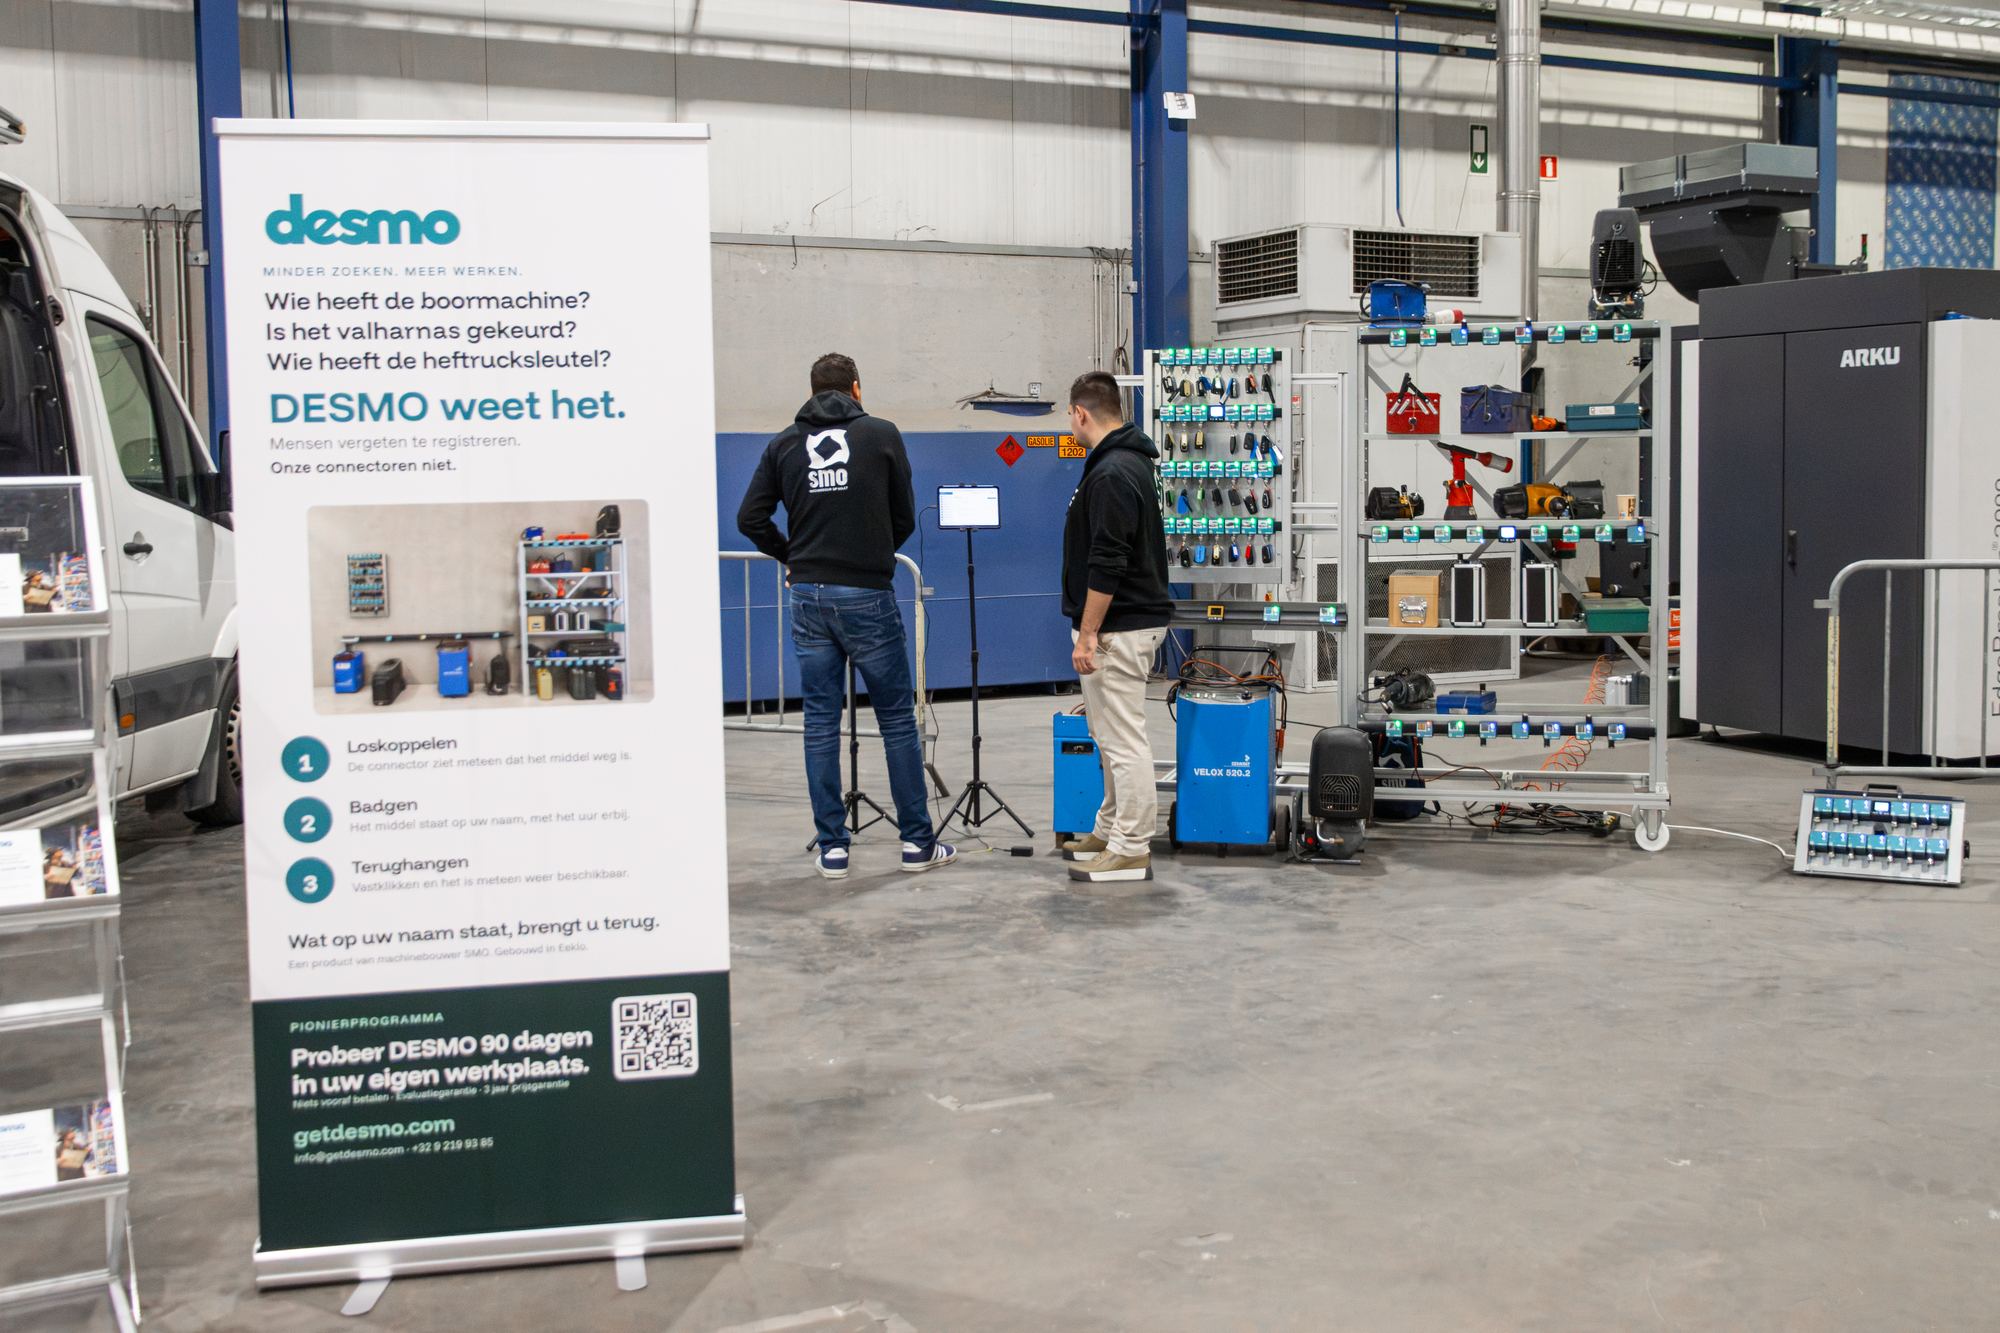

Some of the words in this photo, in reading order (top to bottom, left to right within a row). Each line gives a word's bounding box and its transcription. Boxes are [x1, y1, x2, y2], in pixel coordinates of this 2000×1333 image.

[265, 193, 460, 245] desmo
[263, 266, 325, 276] MINDER
[332, 266, 400, 276] ZOEKEN.
[404, 266, 445, 276] MEER
[453, 266, 521, 276] WERKEN.
[264, 292, 310, 310] Wie
[317, 291, 378, 310] heeft
[384, 291, 414, 309] de
[420, 291, 590, 309] boormachine?
[266, 322, 285, 340] Is
[292, 322, 330, 340] het
[337, 321, 460, 339] valharnas
[466, 320, 576, 343] gekeurd?
[267, 352, 312, 370] Wie
[319, 351, 380, 370] heeft
[387, 351, 416, 369] de
[423, 349, 610, 369] heftrucksleutel?
[1840, 346, 1900, 368] ARKU
[270, 391, 428, 423] DESMO
[440, 391, 540, 420] weet
[551, 389, 625, 419] het.
[270, 437, 332, 450] Mensen
[338, 436, 407, 452] vergeten
[412, 436, 427, 448] te
[432, 435, 520, 450] registreren.
[1028, 437, 1054, 446] GASOLIE
[1062, 447, 1084, 457] 1202
[270, 461, 311, 474] Onze
[316, 460, 416, 473] connectoren
[422, 459, 456, 471] niet.
[348, 737, 457, 754] Loskoppelen
[299, 754, 314, 773] 1
[347, 761, 365, 772] De
[367, 759, 428, 771] connector
[432, 758, 453, 768] ziet
[457, 757, 502, 767] meteen
[505, 755, 523, 765] dat
[527, 754, 546, 764] het
[549, 751, 589, 762] middel
[592, 752, 616, 763] weg
[1193, 768, 1224, 777] VELOX
[1225, 769, 1251, 777] 520.2
[349, 799, 417, 815] Badgen
[300, 814, 316, 834] 2
[349, 822, 371, 832] Het
[374, 818, 415, 830] middel
[419, 818, 448, 829] staat
[451, 819, 466, 829] op
[470, 818, 488, 826] uw
[490, 816, 527, 825] naam,
[530, 813, 552, 823] met
[556, 812, 574, 821] het
[578, 812, 597, 821] uur
[351, 858, 468, 875] Terughangen
[302, 874, 319, 894] 3
[352, 880, 419, 892] Vastklikken
[423, 879, 438, 888] en
[441, 877, 460, 887] het
[463, 877, 474, 886] is
[476, 875, 521, 885] meteen
[525, 873, 552, 883] weer
[557, 869, 630, 881] beschikbaar.
[288, 934, 327, 949] Wat
[332, 934, 357, 949] op
[362, 932, 392, 944] uw
[398, 929, 454, 942] naam
[459, 923, 512, 939] staat,
[517, 919, 581, 936] brengt
[587, 920, 599, 931] u
[603, 917, 660, 932] terug.
[290, 1012, 444, 1032] PIONIERPROGRAMMA
[291, 1045, 385, 1067] Probeer
[389, 1035, 477, 1060] DESMO
[481, 1034, 509, 1053] 90
[513, 1029, 593, 1053] dagen
[322, 1074, 364, 1093] uw
[367, 1067, 439, 1092] eigen
[444, 1055, 589, 1083] werkplaats.
[321, 1095, 351, 1106] vooraf
[352, 1093, 389, 1104] betalen
[483, 1085, 490, 1094] 3
[511, 1079, 570, 1093] prijsgarantie
[293, 1119, 455, 1148] getdesmo.com
[294, 1145, 405, 1164] info@getdesmo.com
[411, 1141, 431, 1153] +32
[433, 1140, 441, 1152] 9
[442, 1139, 463, 1151] 219
[464, 1138, 478, 1149] 93
[479, 1136, 494, 1148] 85
